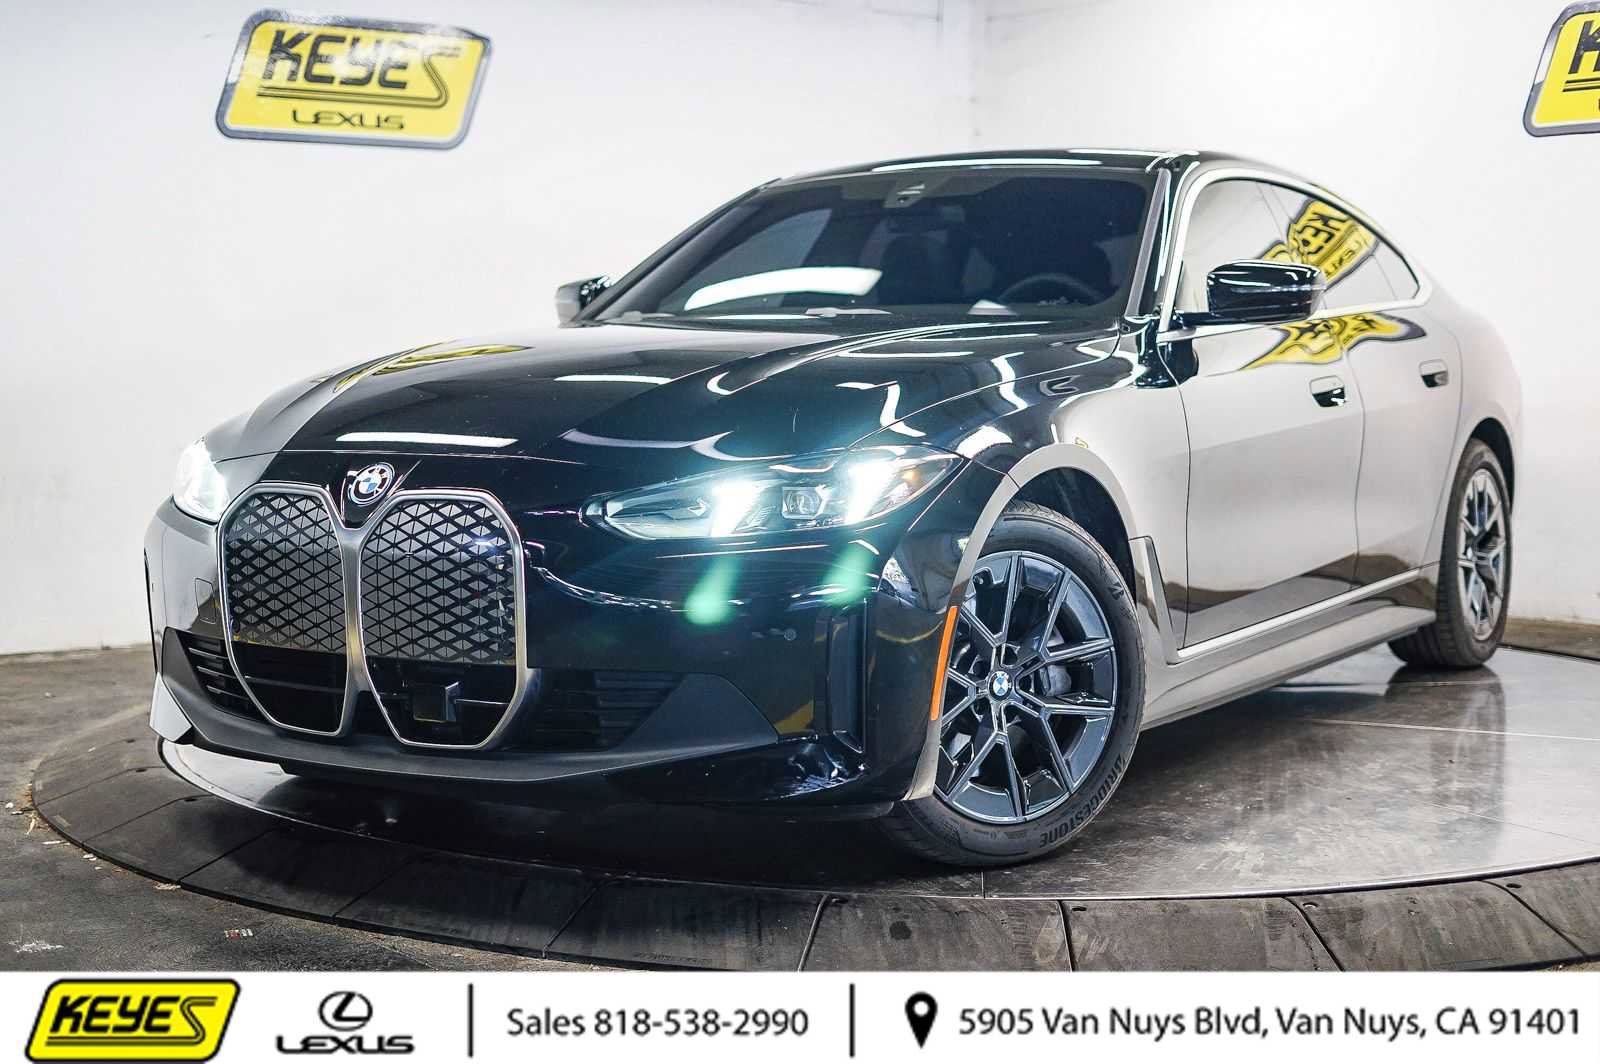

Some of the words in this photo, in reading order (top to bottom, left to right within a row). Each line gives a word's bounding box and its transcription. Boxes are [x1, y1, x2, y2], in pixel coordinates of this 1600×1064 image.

[257, 29, 462, 109] KEYES
[292, 109, 405, 130] LEXUS
[1039, 754, 1127, 848] BRIDGESTONE
